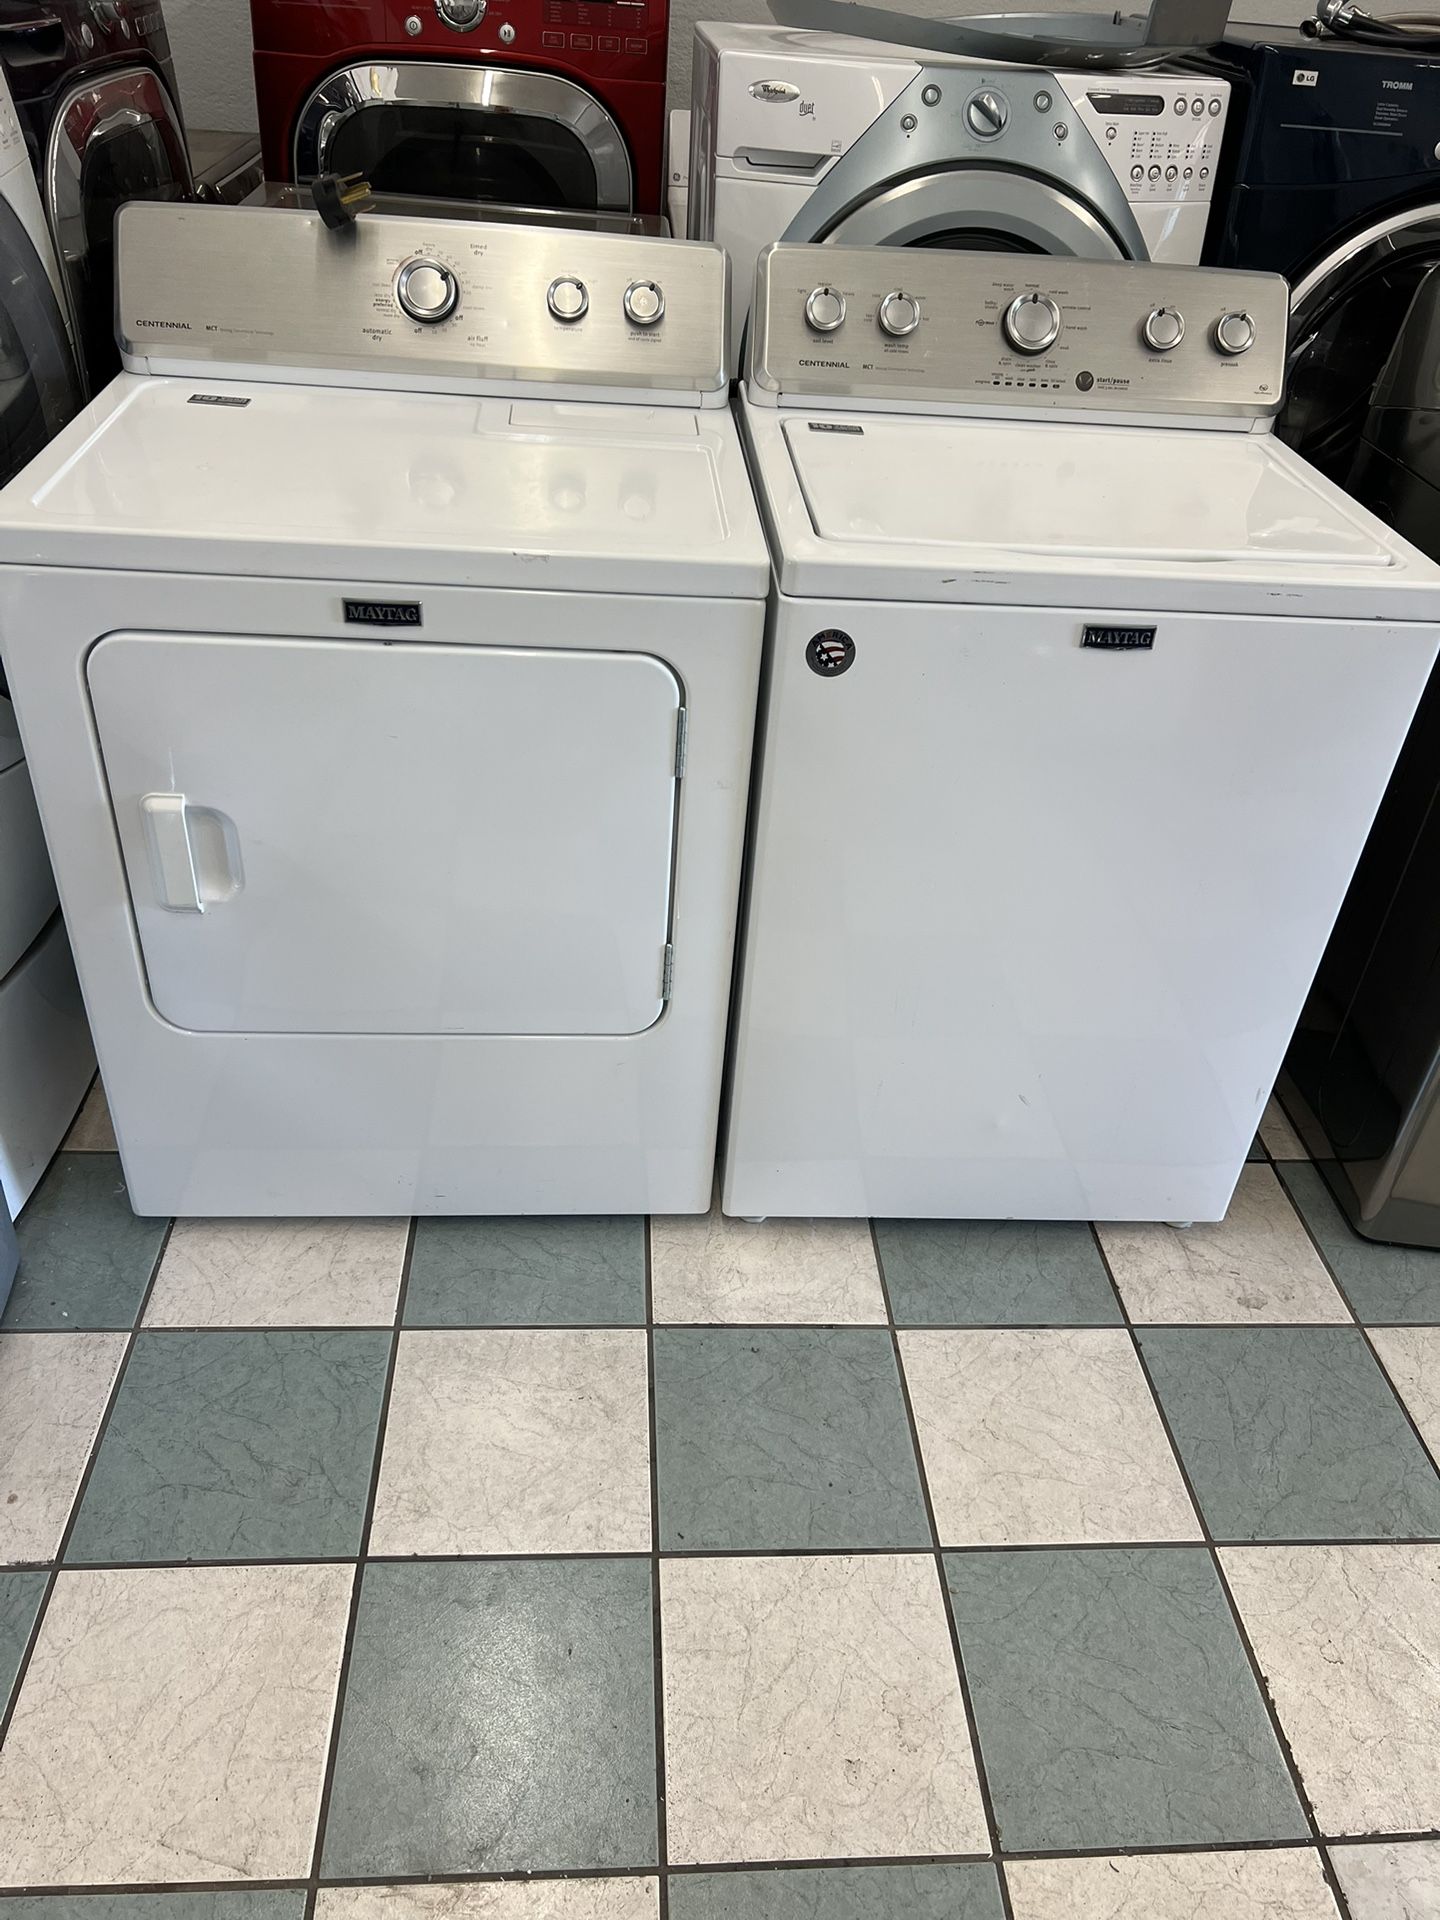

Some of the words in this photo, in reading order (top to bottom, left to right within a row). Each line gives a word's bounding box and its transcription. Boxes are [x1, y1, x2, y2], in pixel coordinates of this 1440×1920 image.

[761, 84, 786, 95] Whirlpool
[1382, 80, 1413, 90] TROMM
[799, 100, 815, 117] duet
[470, 243, 488, 251] timed
[136, 319, 192, 330] CENTENNIAL
[205, 324, 218, 332] MCT
[371, 334, 382, 342] dry
[799, 360, 850, 369] CENTENNIAL
[1097, 376, 1130, 385] start/pause
[347, 605, 418, 621] MAYTAG
[1087, 629, 1151, 645] MAYTAG
